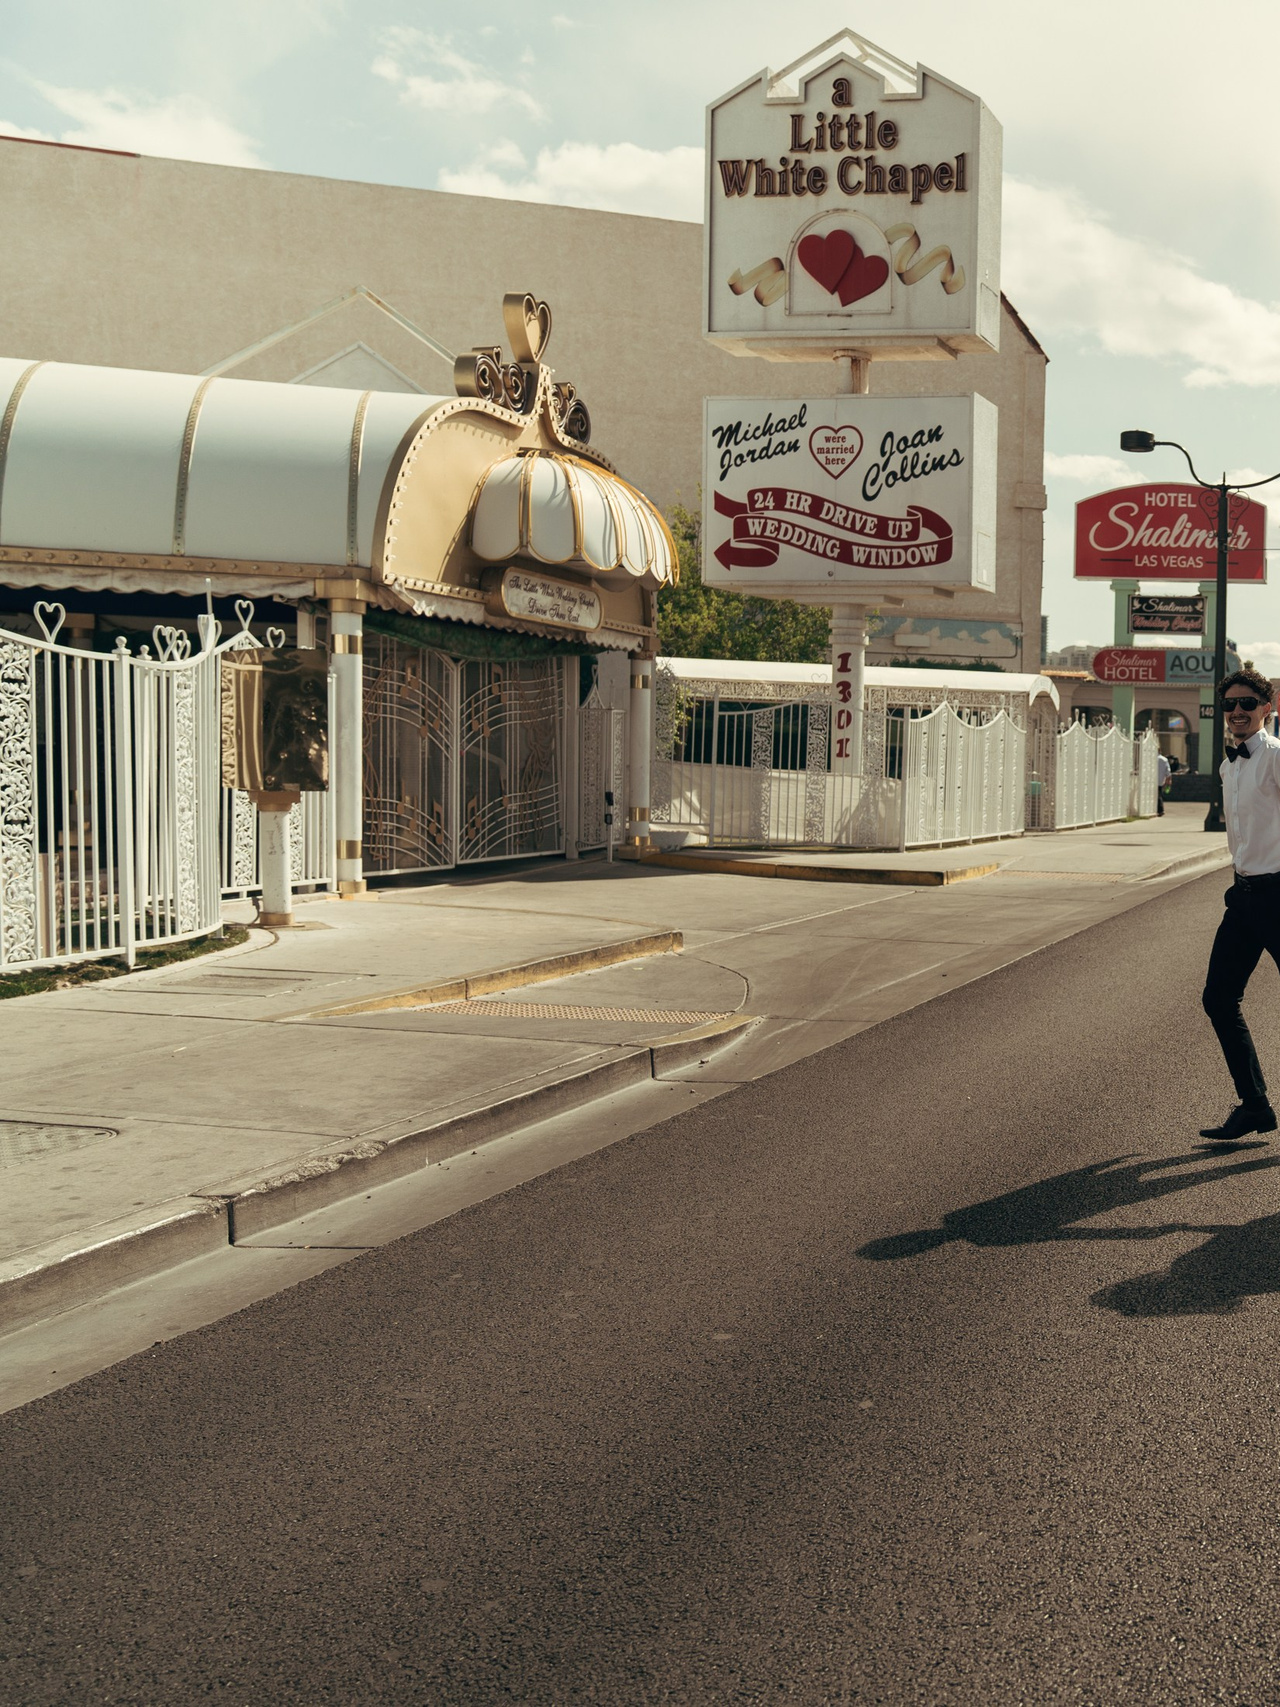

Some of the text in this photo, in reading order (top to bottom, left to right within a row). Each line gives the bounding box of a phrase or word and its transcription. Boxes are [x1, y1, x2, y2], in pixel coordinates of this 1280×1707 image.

[831, 77, 853, 107] a
[789, 111, 898, 153] Little
[717, 152, 967, 205] White Chapel
[712, 403, 807, 449] Michael
[824, 434, 847, 444] were
[719, 436, 801, 482] Jordan
[816, 444, 855, 455] married
[825, 455, 846, 465] here
[880, 424, 944, 472] Joan
[862, 448, 965, 502] Collins
[753, 491, 913, 539] 24 HR DRIVE UP
[1145, 493, 1197, 508] HOTEL
[746, 518, 939, 567] WEDDING WINDOW
[1135, 555, 1204, 568] LAS VEGAS
[509, 575, 521, 590] The
[523, 578, 538, 594] Little
[555, 586, 578, 607] Wedding
[579, 592, 596, 610] Chapel
[1142, 598, 1193, 613] Shalimar
[528, 597, 548, 616] Drive
[567, 606, 580, 623] Exit
[1104, 651, 1158, 667] Shalimar
[1104, 667, 1157, 680] HOTEL
[1170, 655, 1230, 673] AQU
[836, 652, 852, 758] 1301
